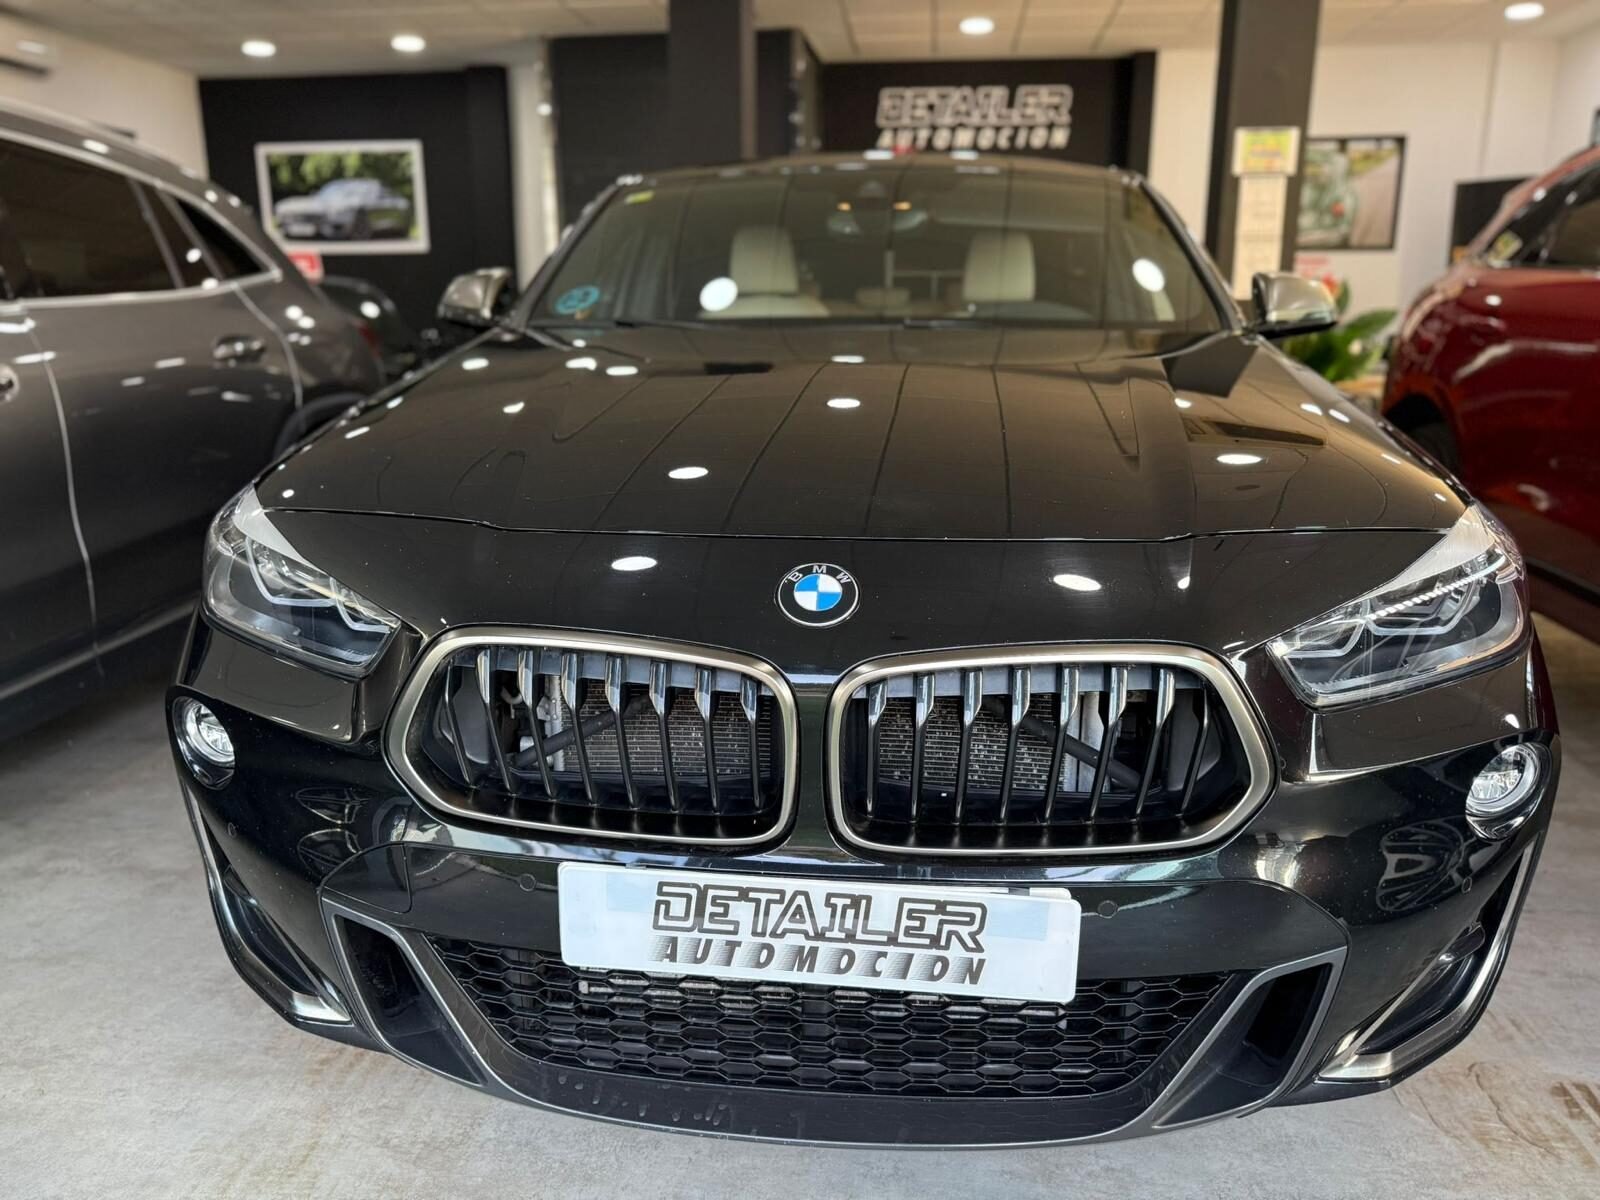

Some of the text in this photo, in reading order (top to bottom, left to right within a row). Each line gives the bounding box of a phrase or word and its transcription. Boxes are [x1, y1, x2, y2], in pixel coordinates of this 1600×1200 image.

[876, 85, 1074, 129] DETAILER
[876, 127, 1071, 150] AUTOMOCION
[787, 564, 851, 584] BMW
[652, 881, 988, 953] DETAILER
[648, 935, 986, 985] AUTOMOCION
